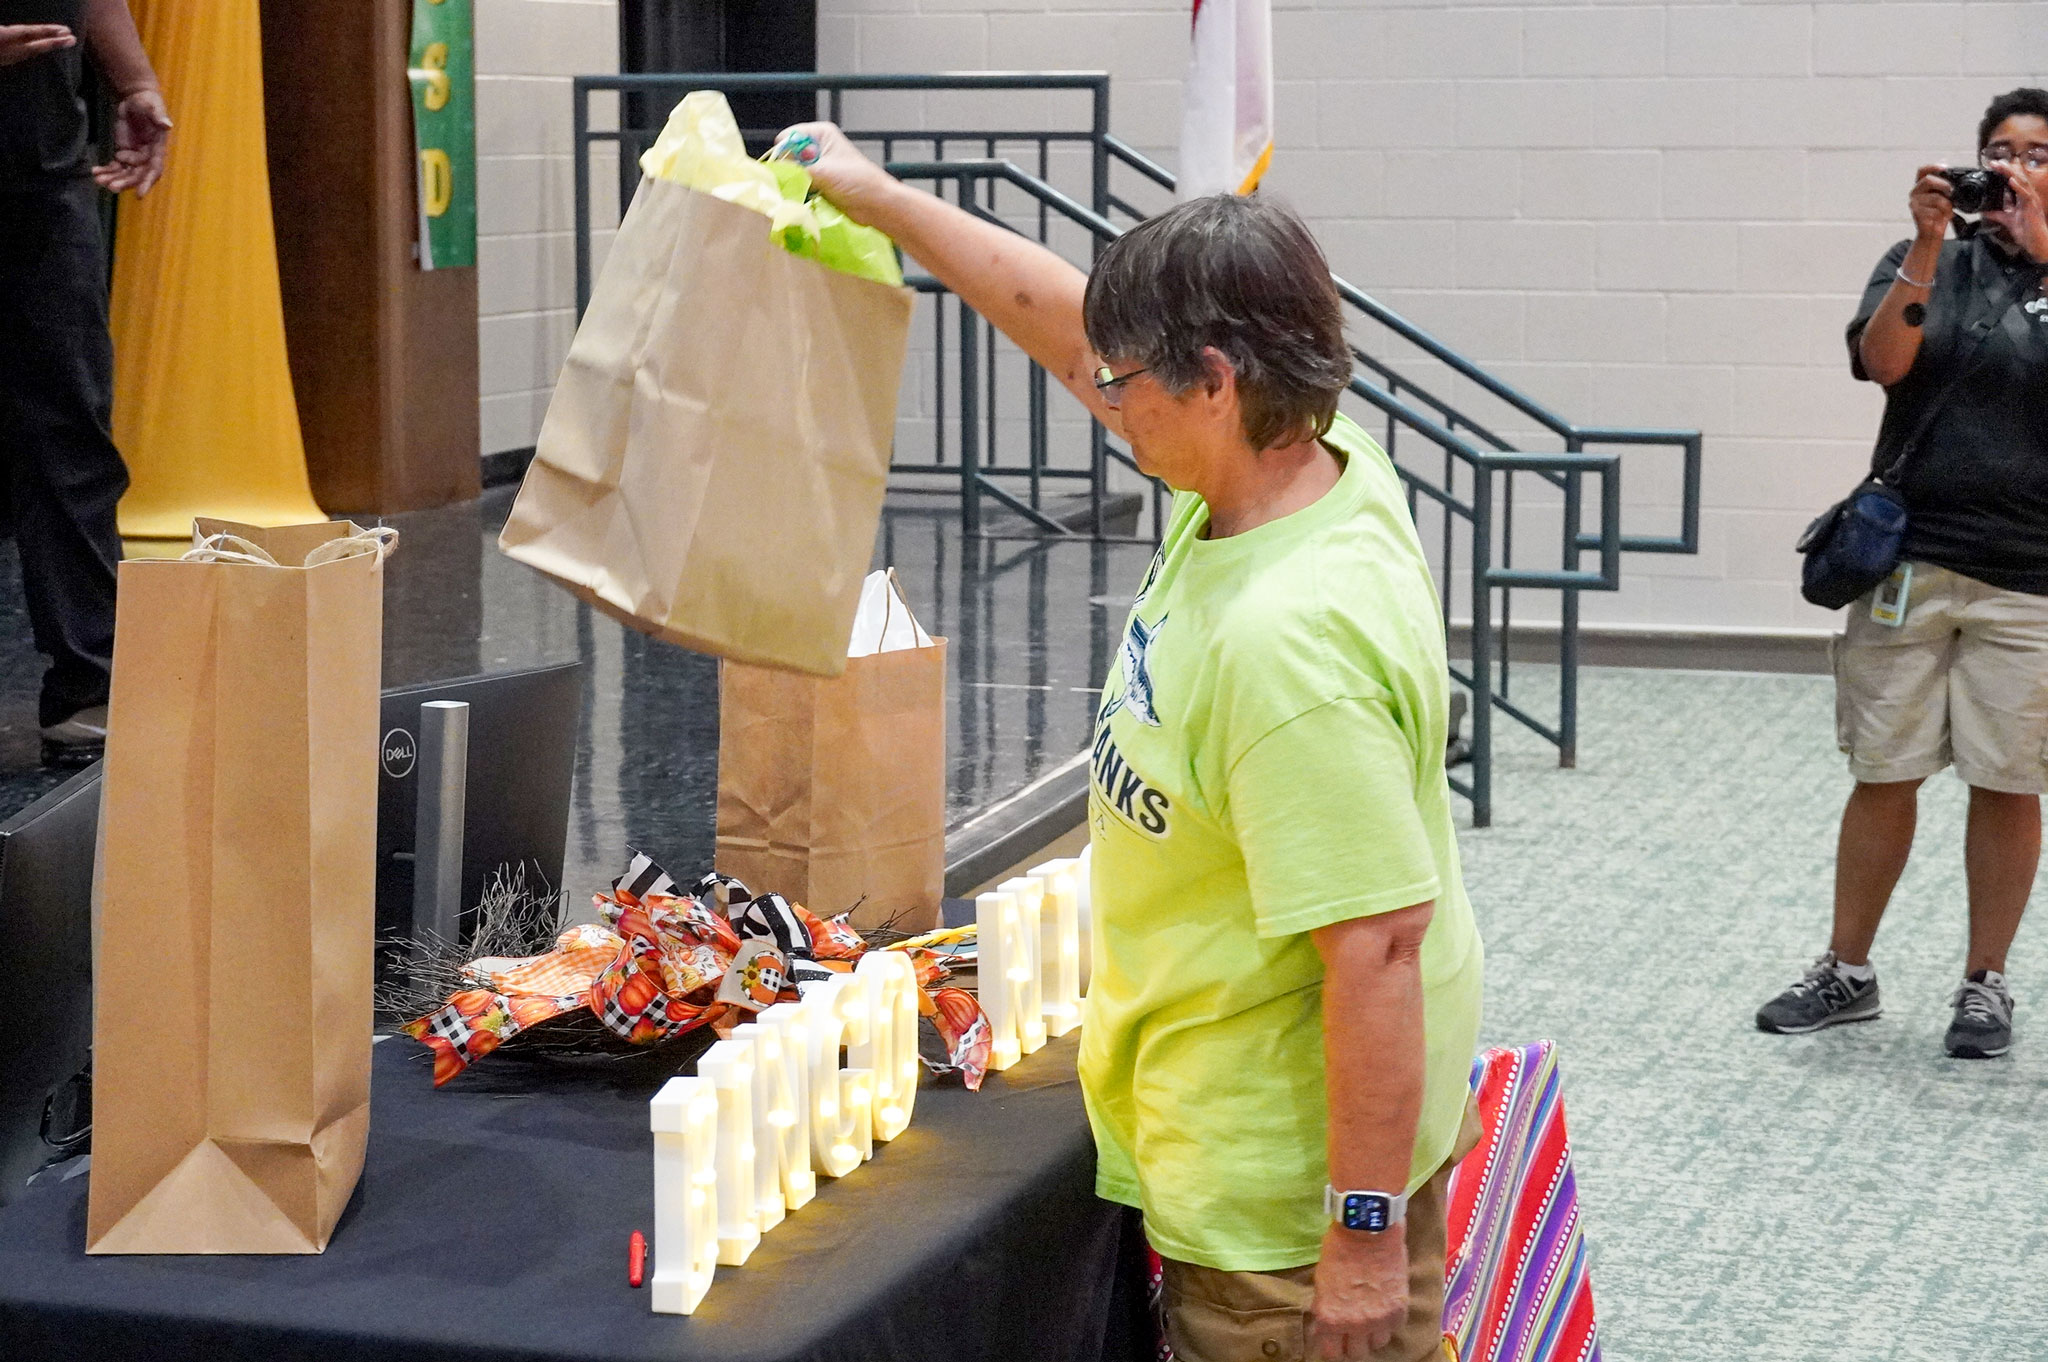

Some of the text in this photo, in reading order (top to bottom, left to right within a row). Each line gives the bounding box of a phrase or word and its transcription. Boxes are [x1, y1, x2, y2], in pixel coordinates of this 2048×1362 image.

[420, 0, 452, 218] SD
[386, 745, 413, 761] DELL
[1092, 723, 1169, 834] ANKS
[976, 843, 1092, 1071] NI
